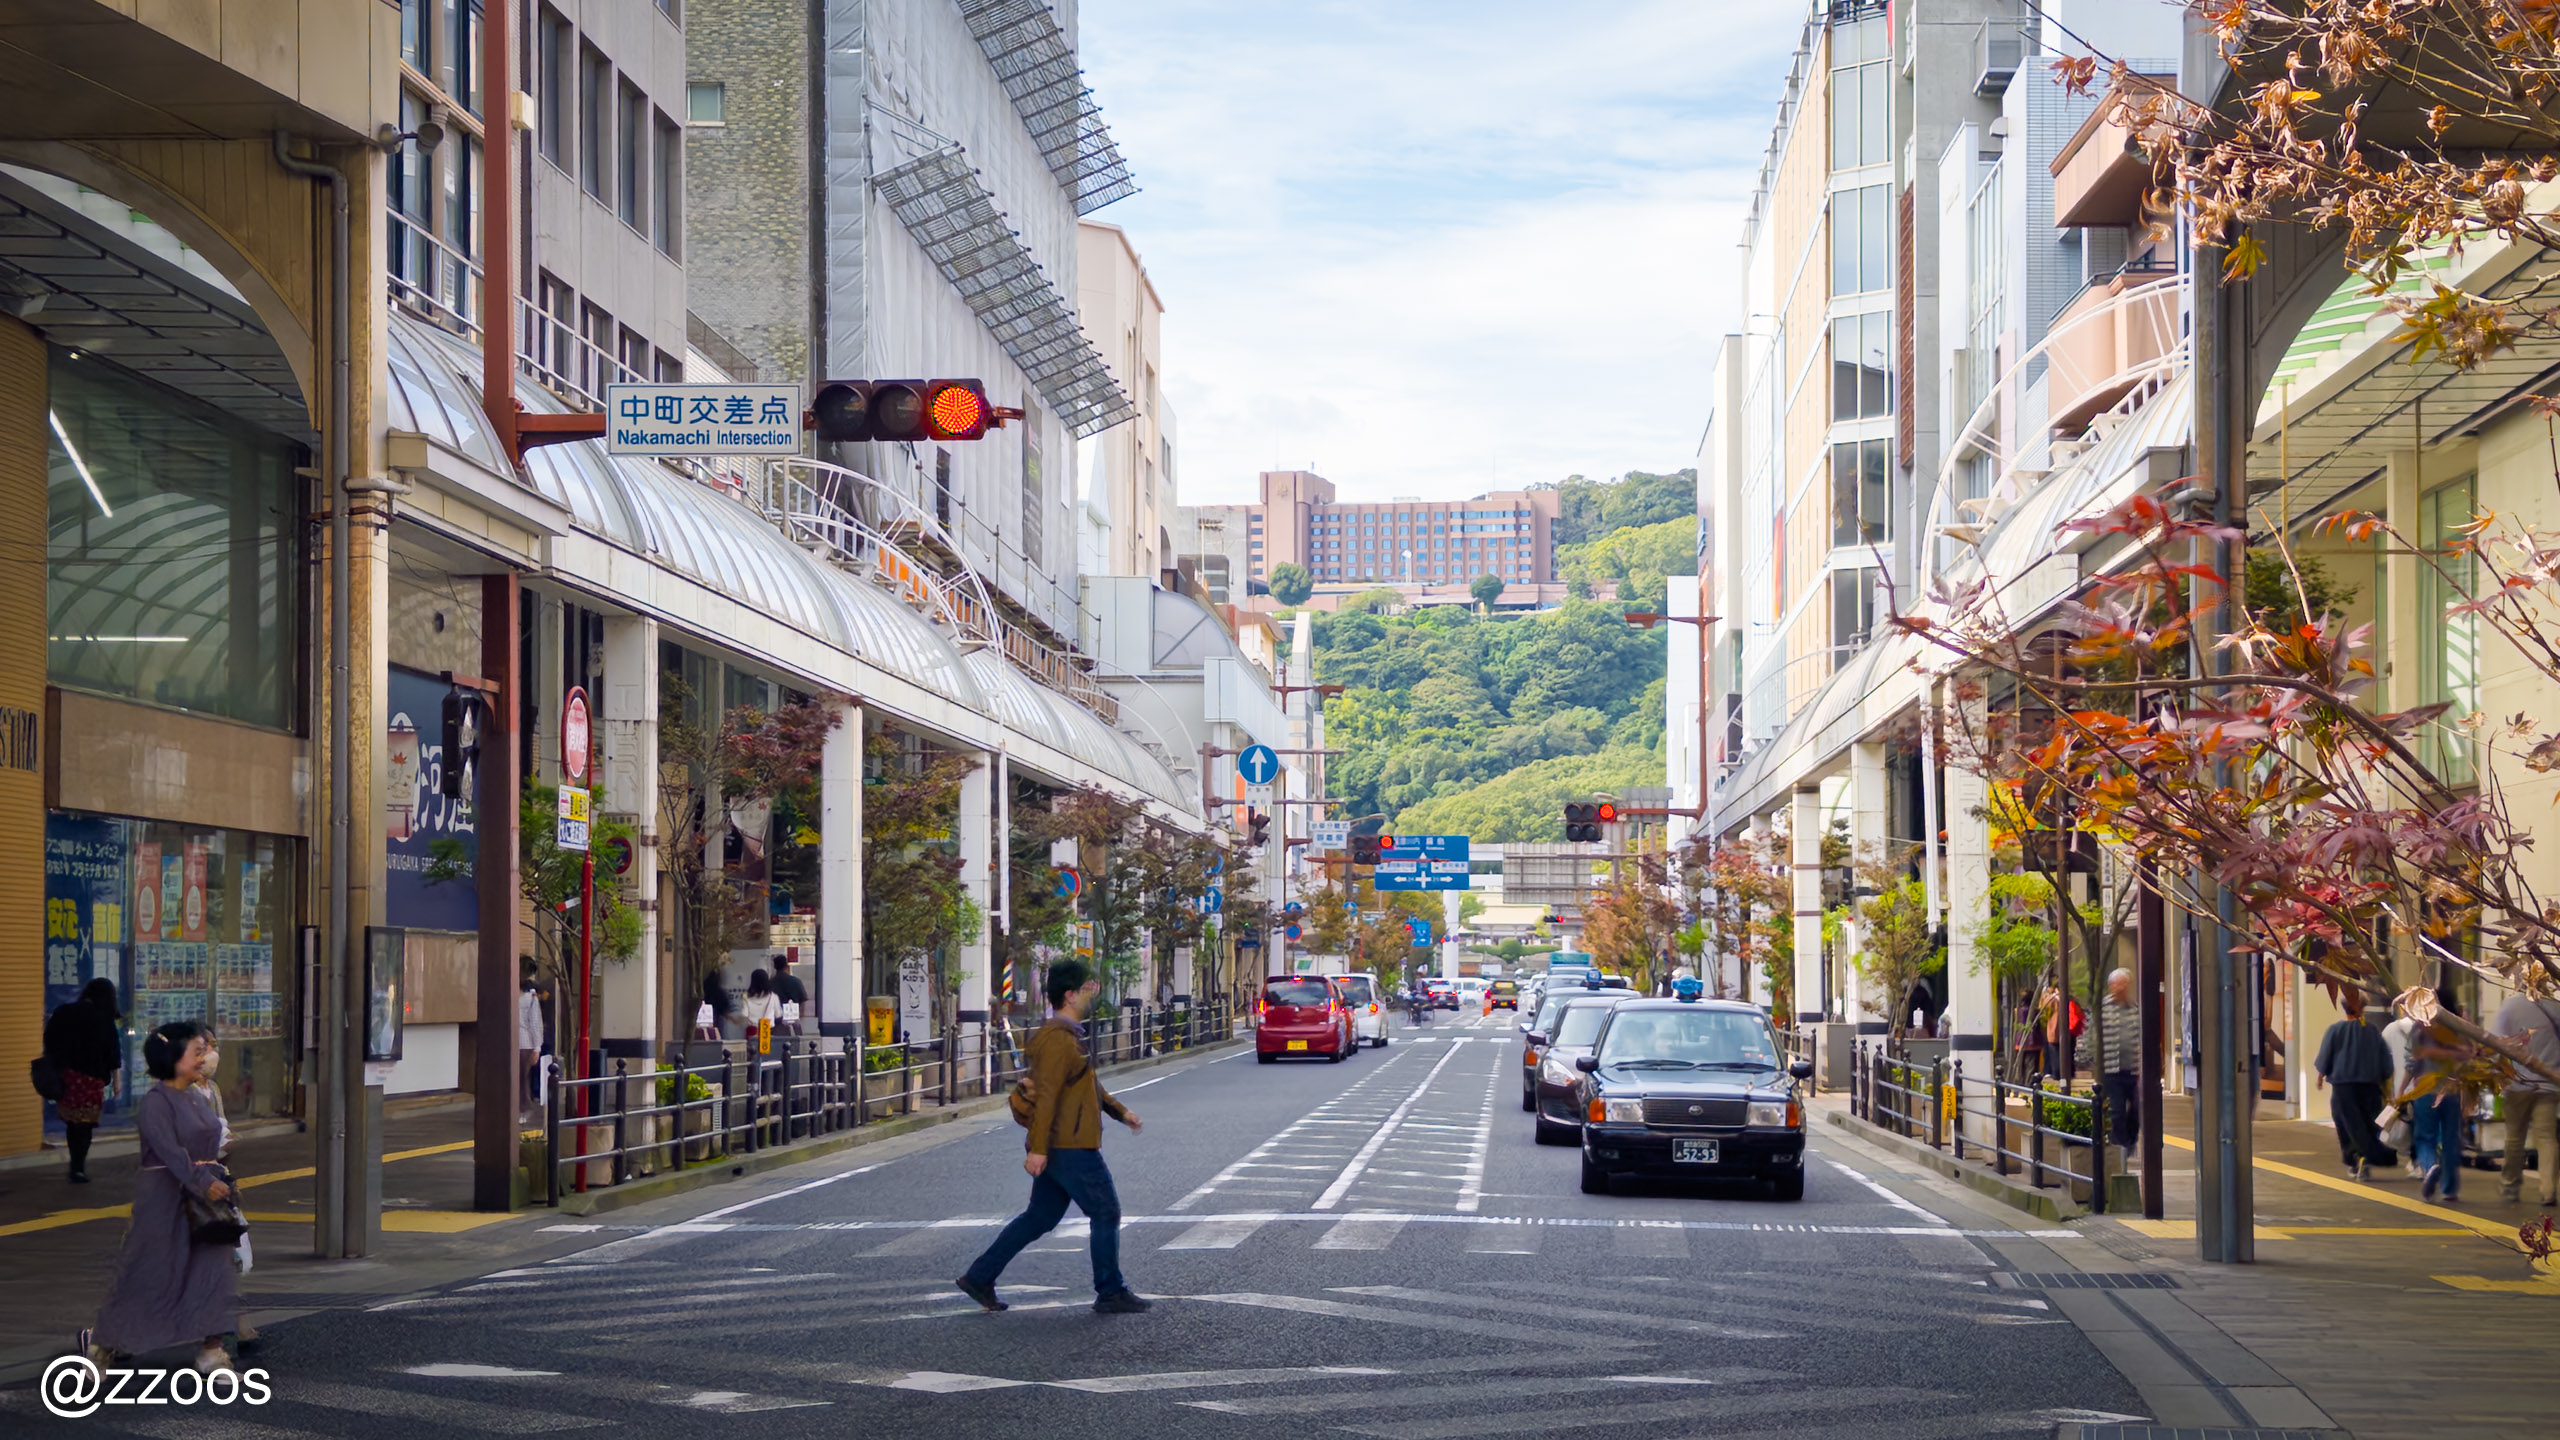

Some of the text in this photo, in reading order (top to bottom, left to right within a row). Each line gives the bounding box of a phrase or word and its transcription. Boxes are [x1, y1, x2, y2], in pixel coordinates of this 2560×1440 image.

[620, 394, 789, 425] 中町交差点
[617, 429, 792, 446] Nakamachi Intersection
